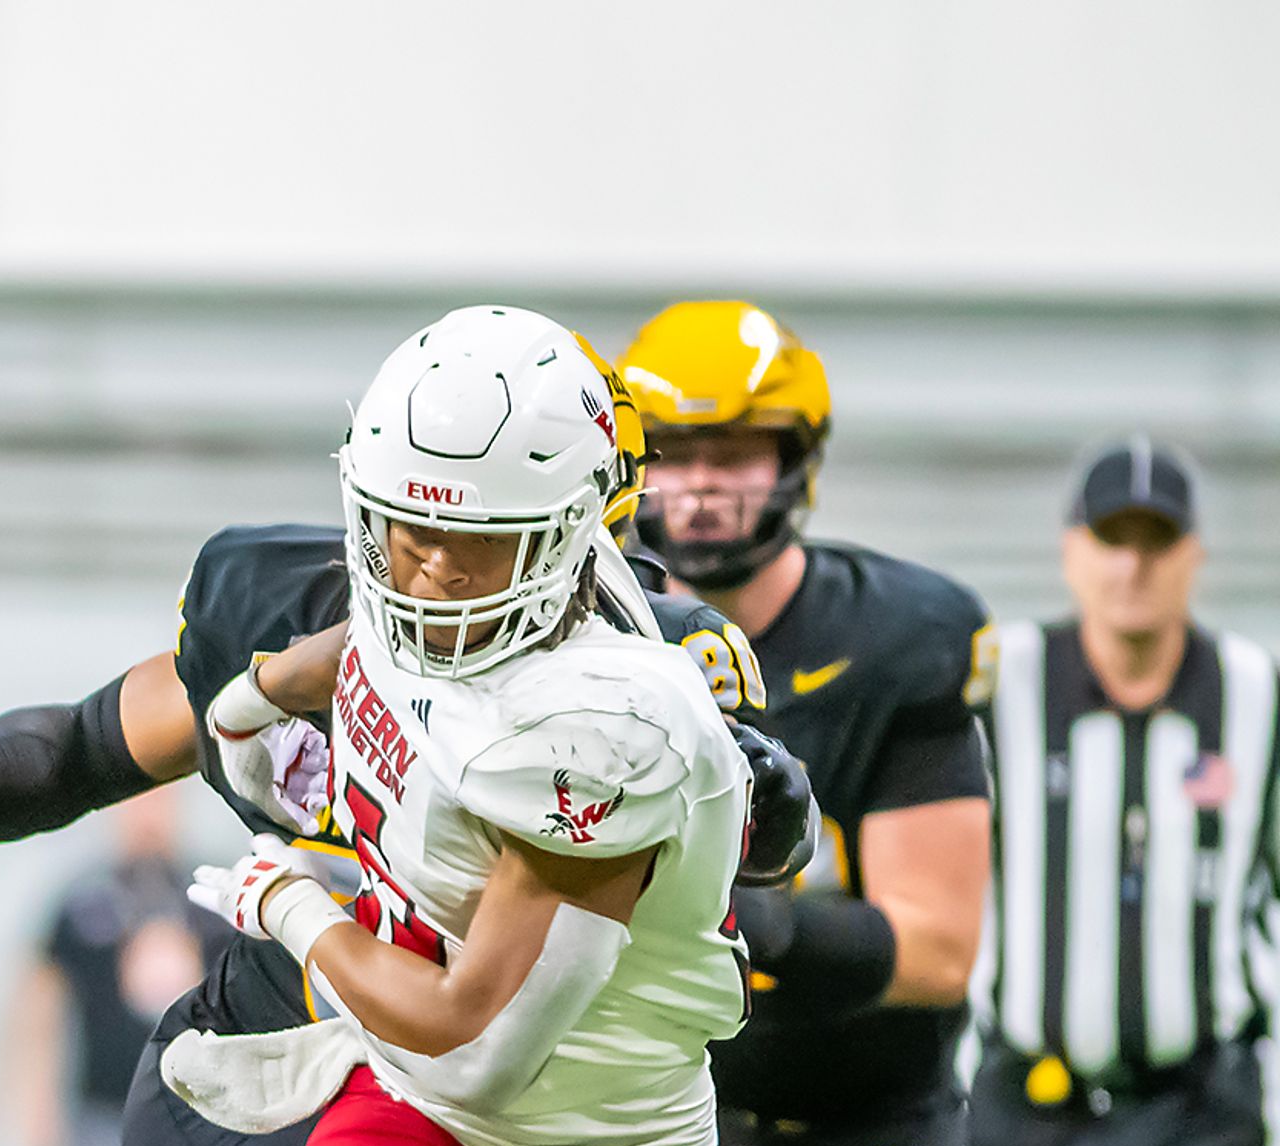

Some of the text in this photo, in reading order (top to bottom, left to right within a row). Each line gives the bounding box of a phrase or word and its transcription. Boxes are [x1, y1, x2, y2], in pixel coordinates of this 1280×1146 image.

[406, 481, 464, 506] EWU
[336, 682, 406, 804] HINGTON
[343, 645, 419, 779] STERN
